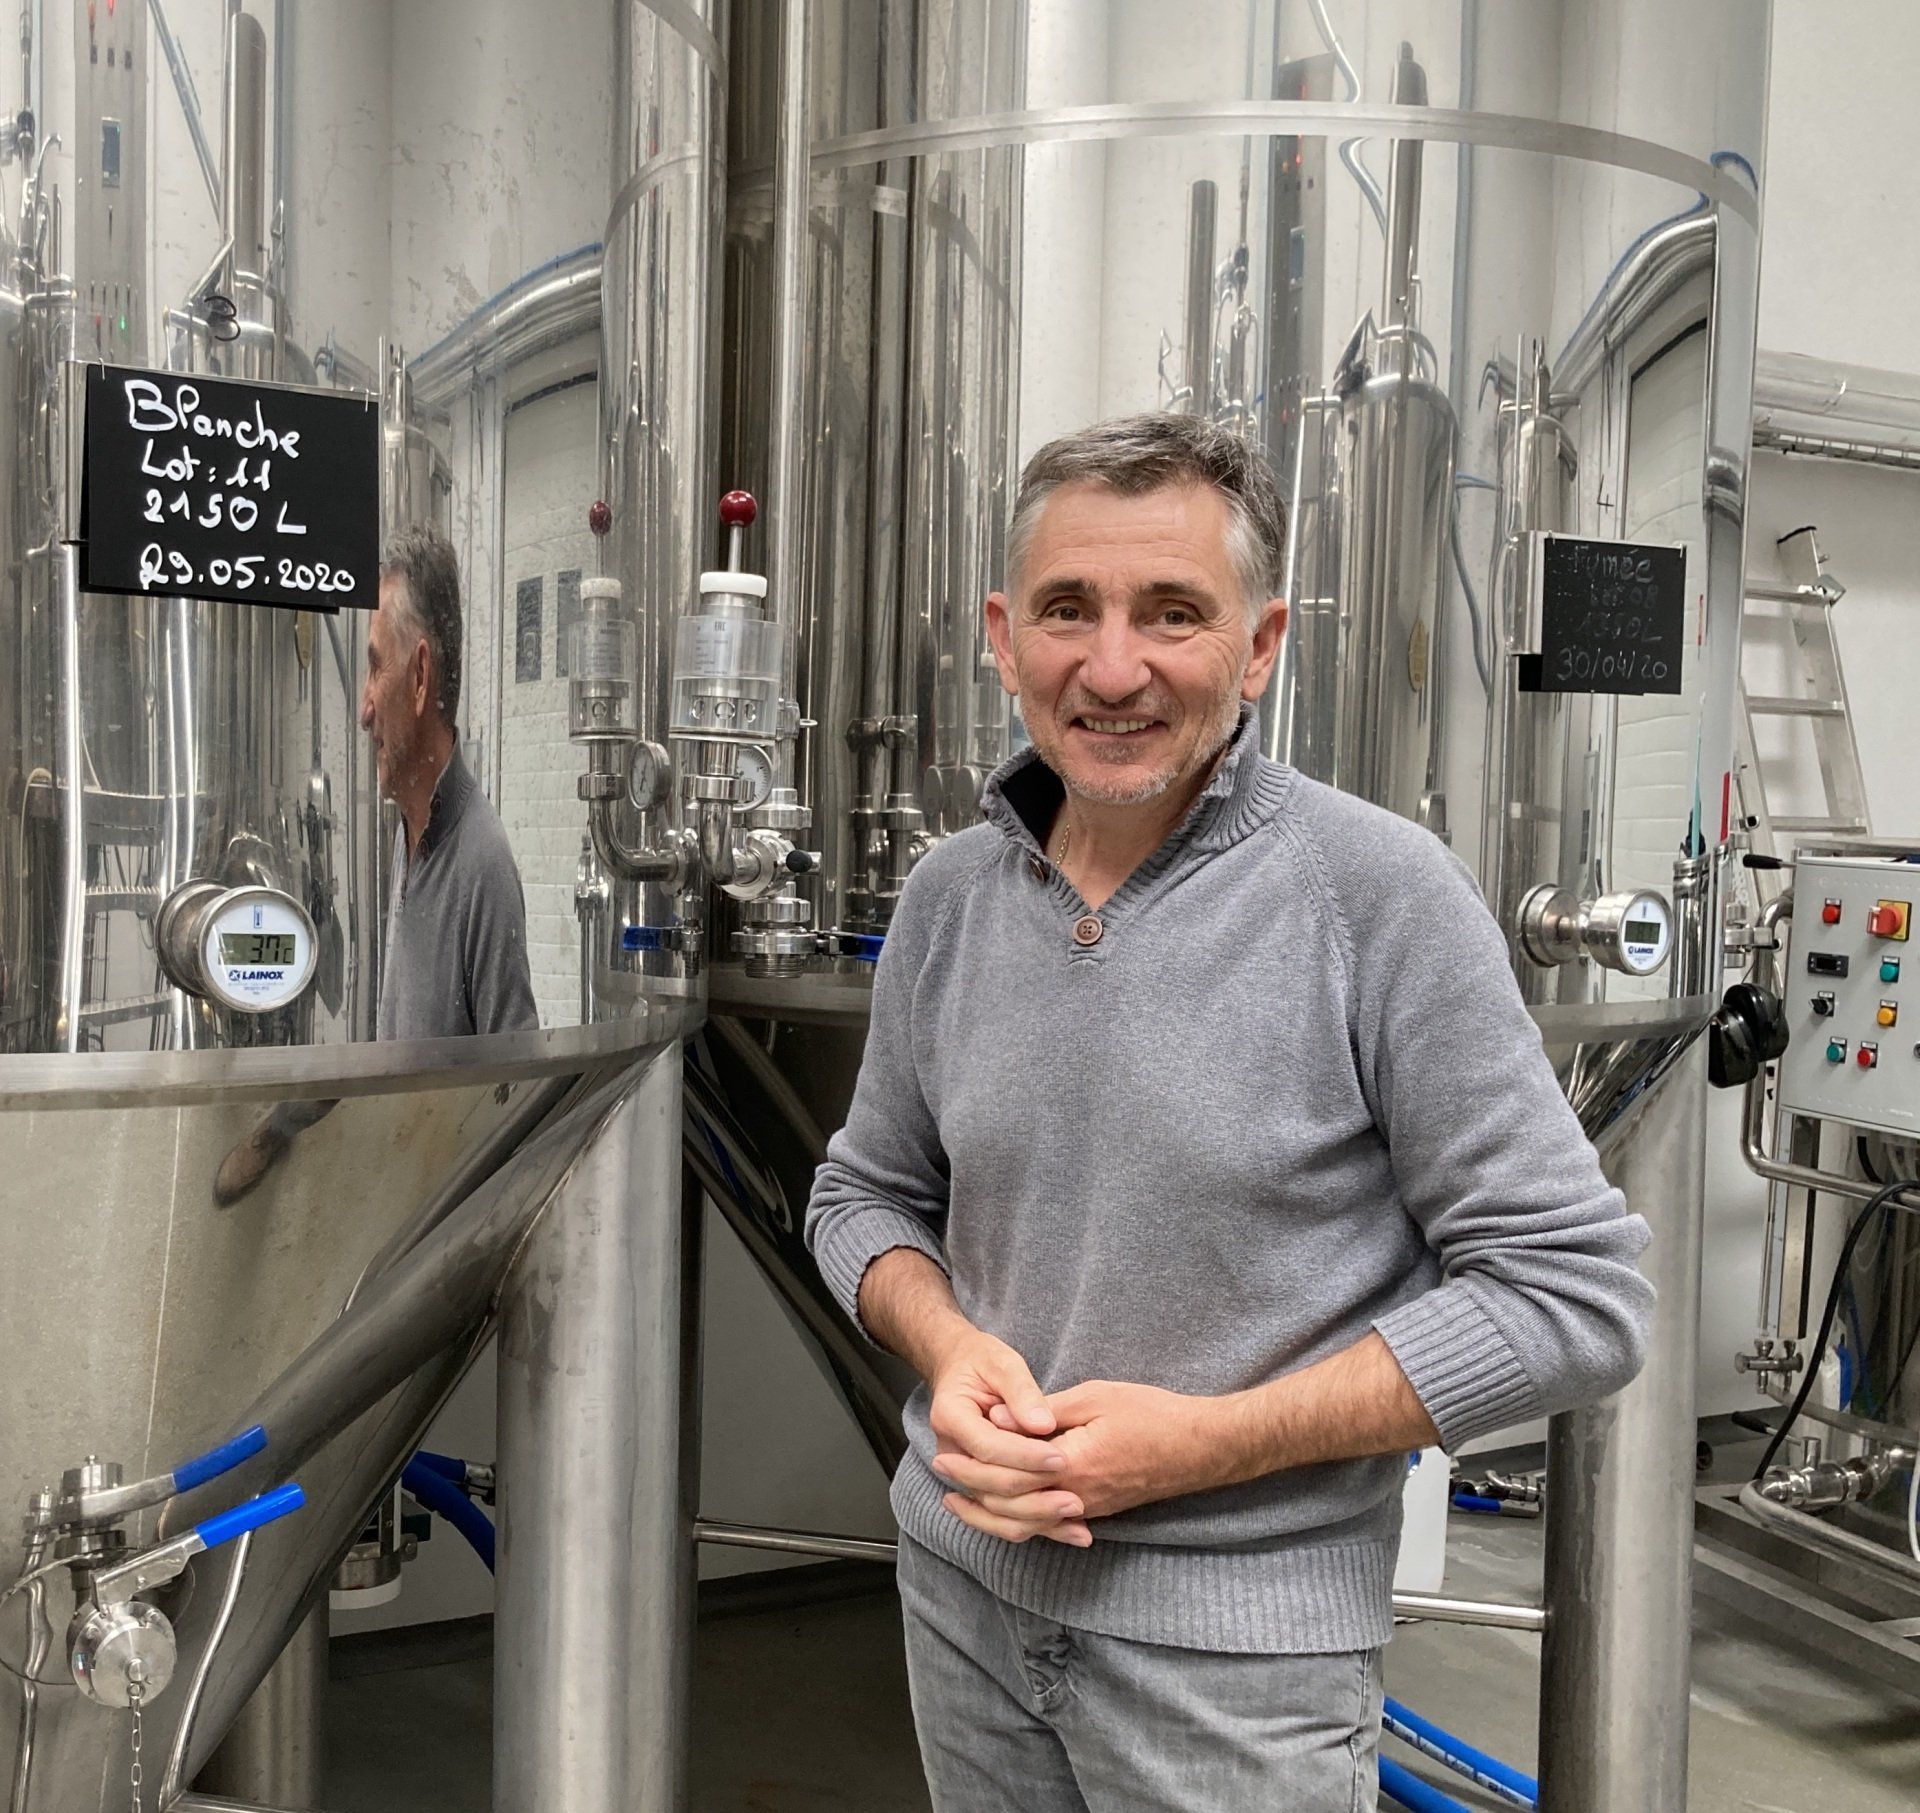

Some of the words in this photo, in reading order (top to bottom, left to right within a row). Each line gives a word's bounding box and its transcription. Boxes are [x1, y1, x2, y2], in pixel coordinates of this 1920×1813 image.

[125, 379, 301, 458] Blanche
[143, 488, 258, 532] 2150
[276, 501, 307, 534] L
[139, 543, 356, 590] 29.05.2020
[1557, 647, 1668, 682] 30/04/20
[242, 970, 285, 980] LAINOX
